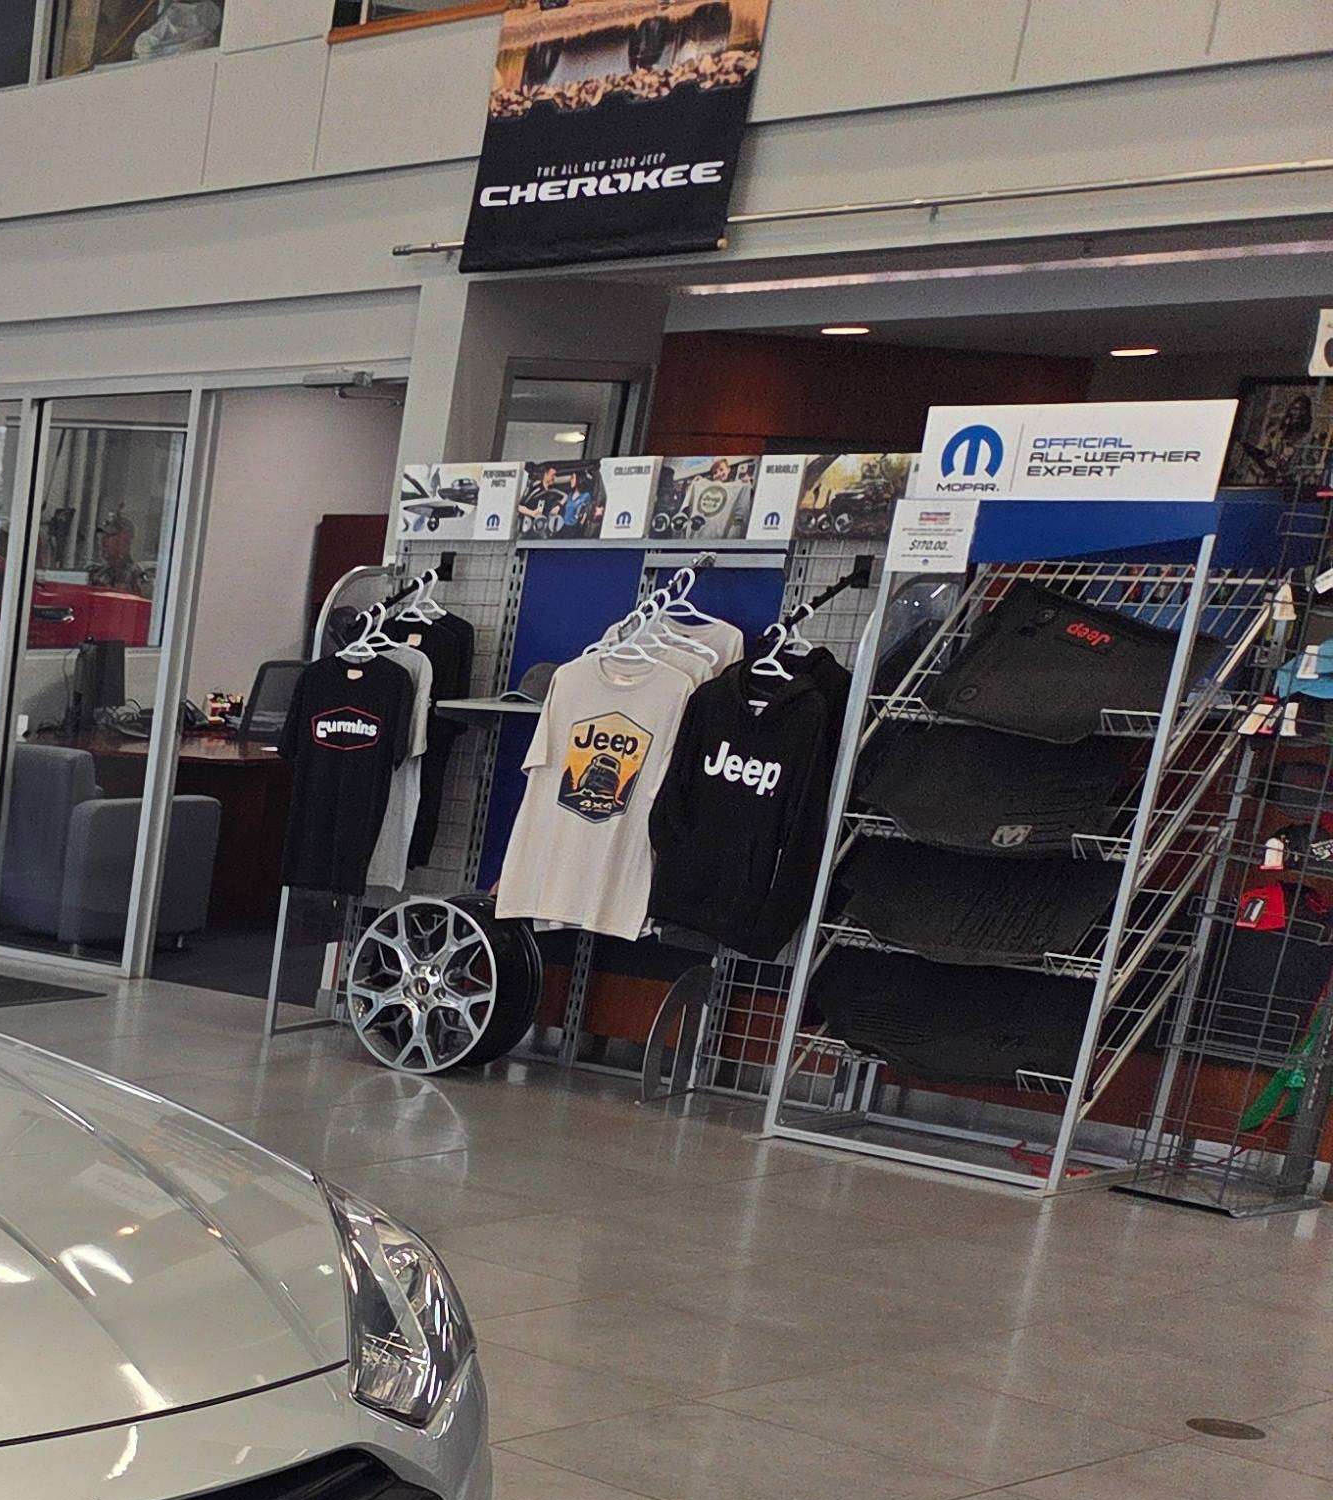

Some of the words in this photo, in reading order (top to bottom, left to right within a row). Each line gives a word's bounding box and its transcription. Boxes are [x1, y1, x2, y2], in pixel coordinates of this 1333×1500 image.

[537, 166, 556, 178] THE
[561, 163, 578, 175] ALL
[584, 160, 606, 172] NEW
[640, 152, 666, 166] JEEP
[479, 160, 726, 207] CHEROKEE
[1033, 436, 1133, 450] OFFICIAL
[1029, 450, 1201, 463] ALL-WEATHER
[1026, 465, 1121, 477] EXPERT
[1066, 622, 1111, 646] Jeep
[574, 724, 639, 759] Jeep
[704, 740, 782, 796] Jeep
